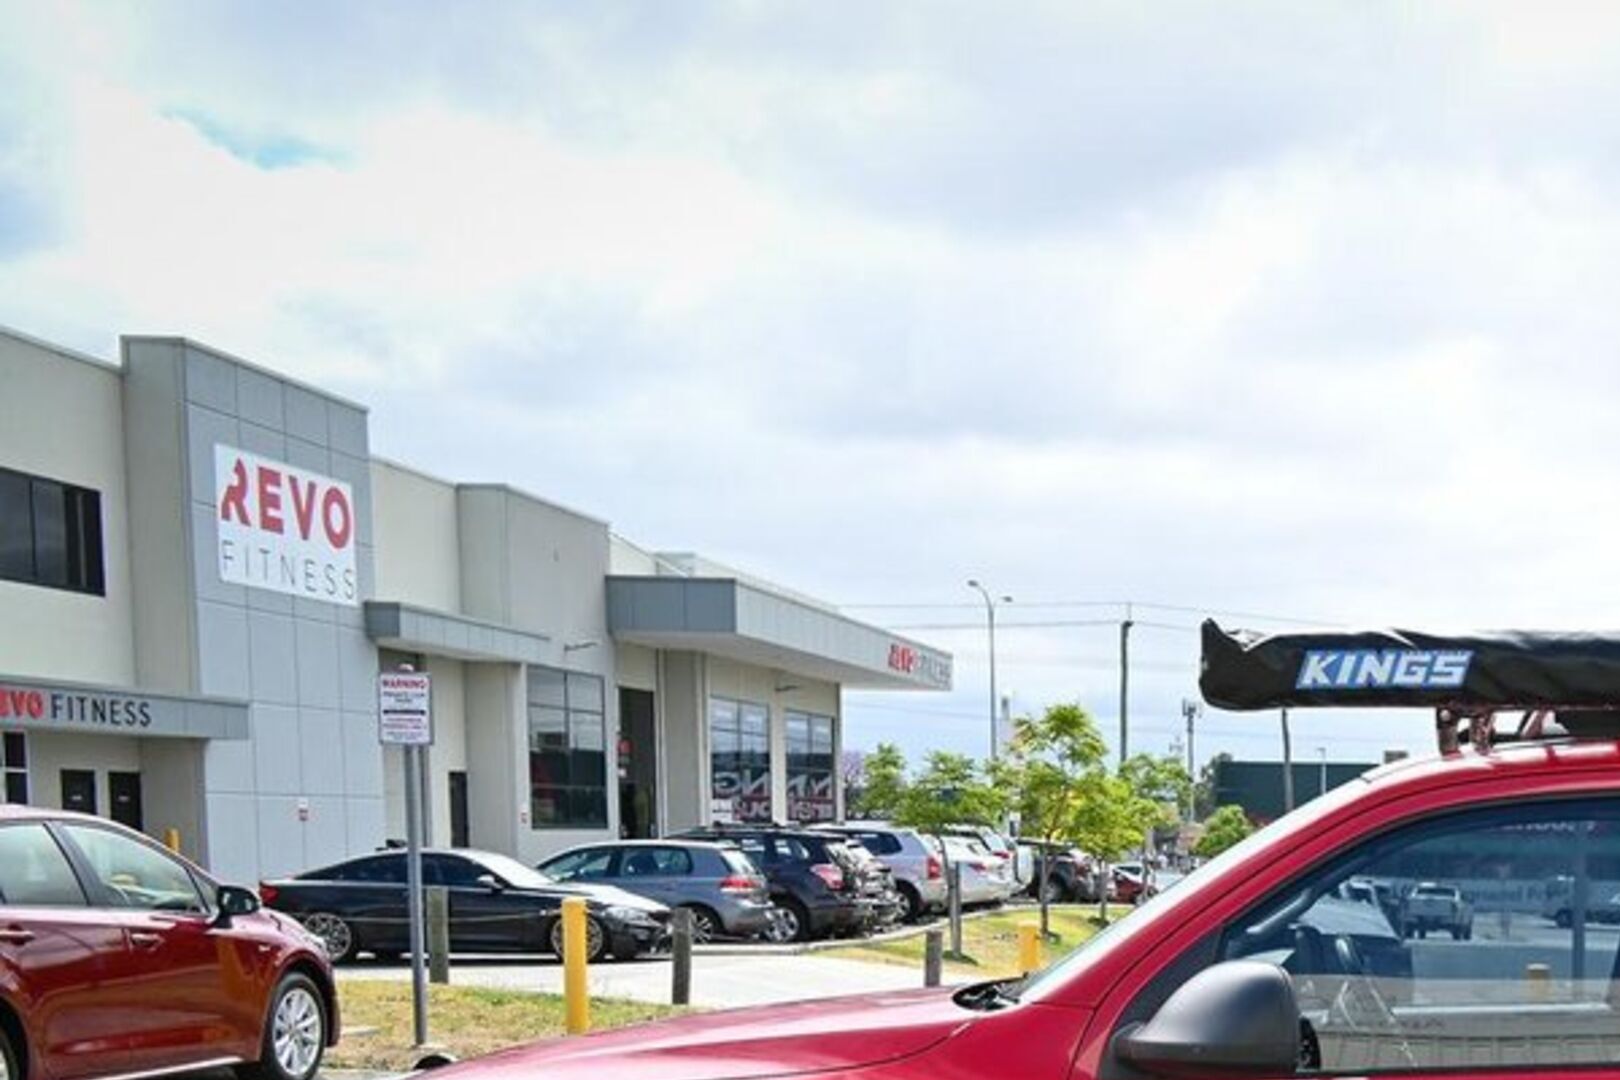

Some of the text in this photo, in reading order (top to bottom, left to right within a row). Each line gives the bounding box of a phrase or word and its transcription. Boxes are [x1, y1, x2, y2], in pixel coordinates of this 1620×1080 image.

[221, 458, 351, 549] REVO
[221, 540, 354, 600] FITNESS
[1300, 651, 1472, 687] KINGS
[51, 693, 152, 727] FITNESS
